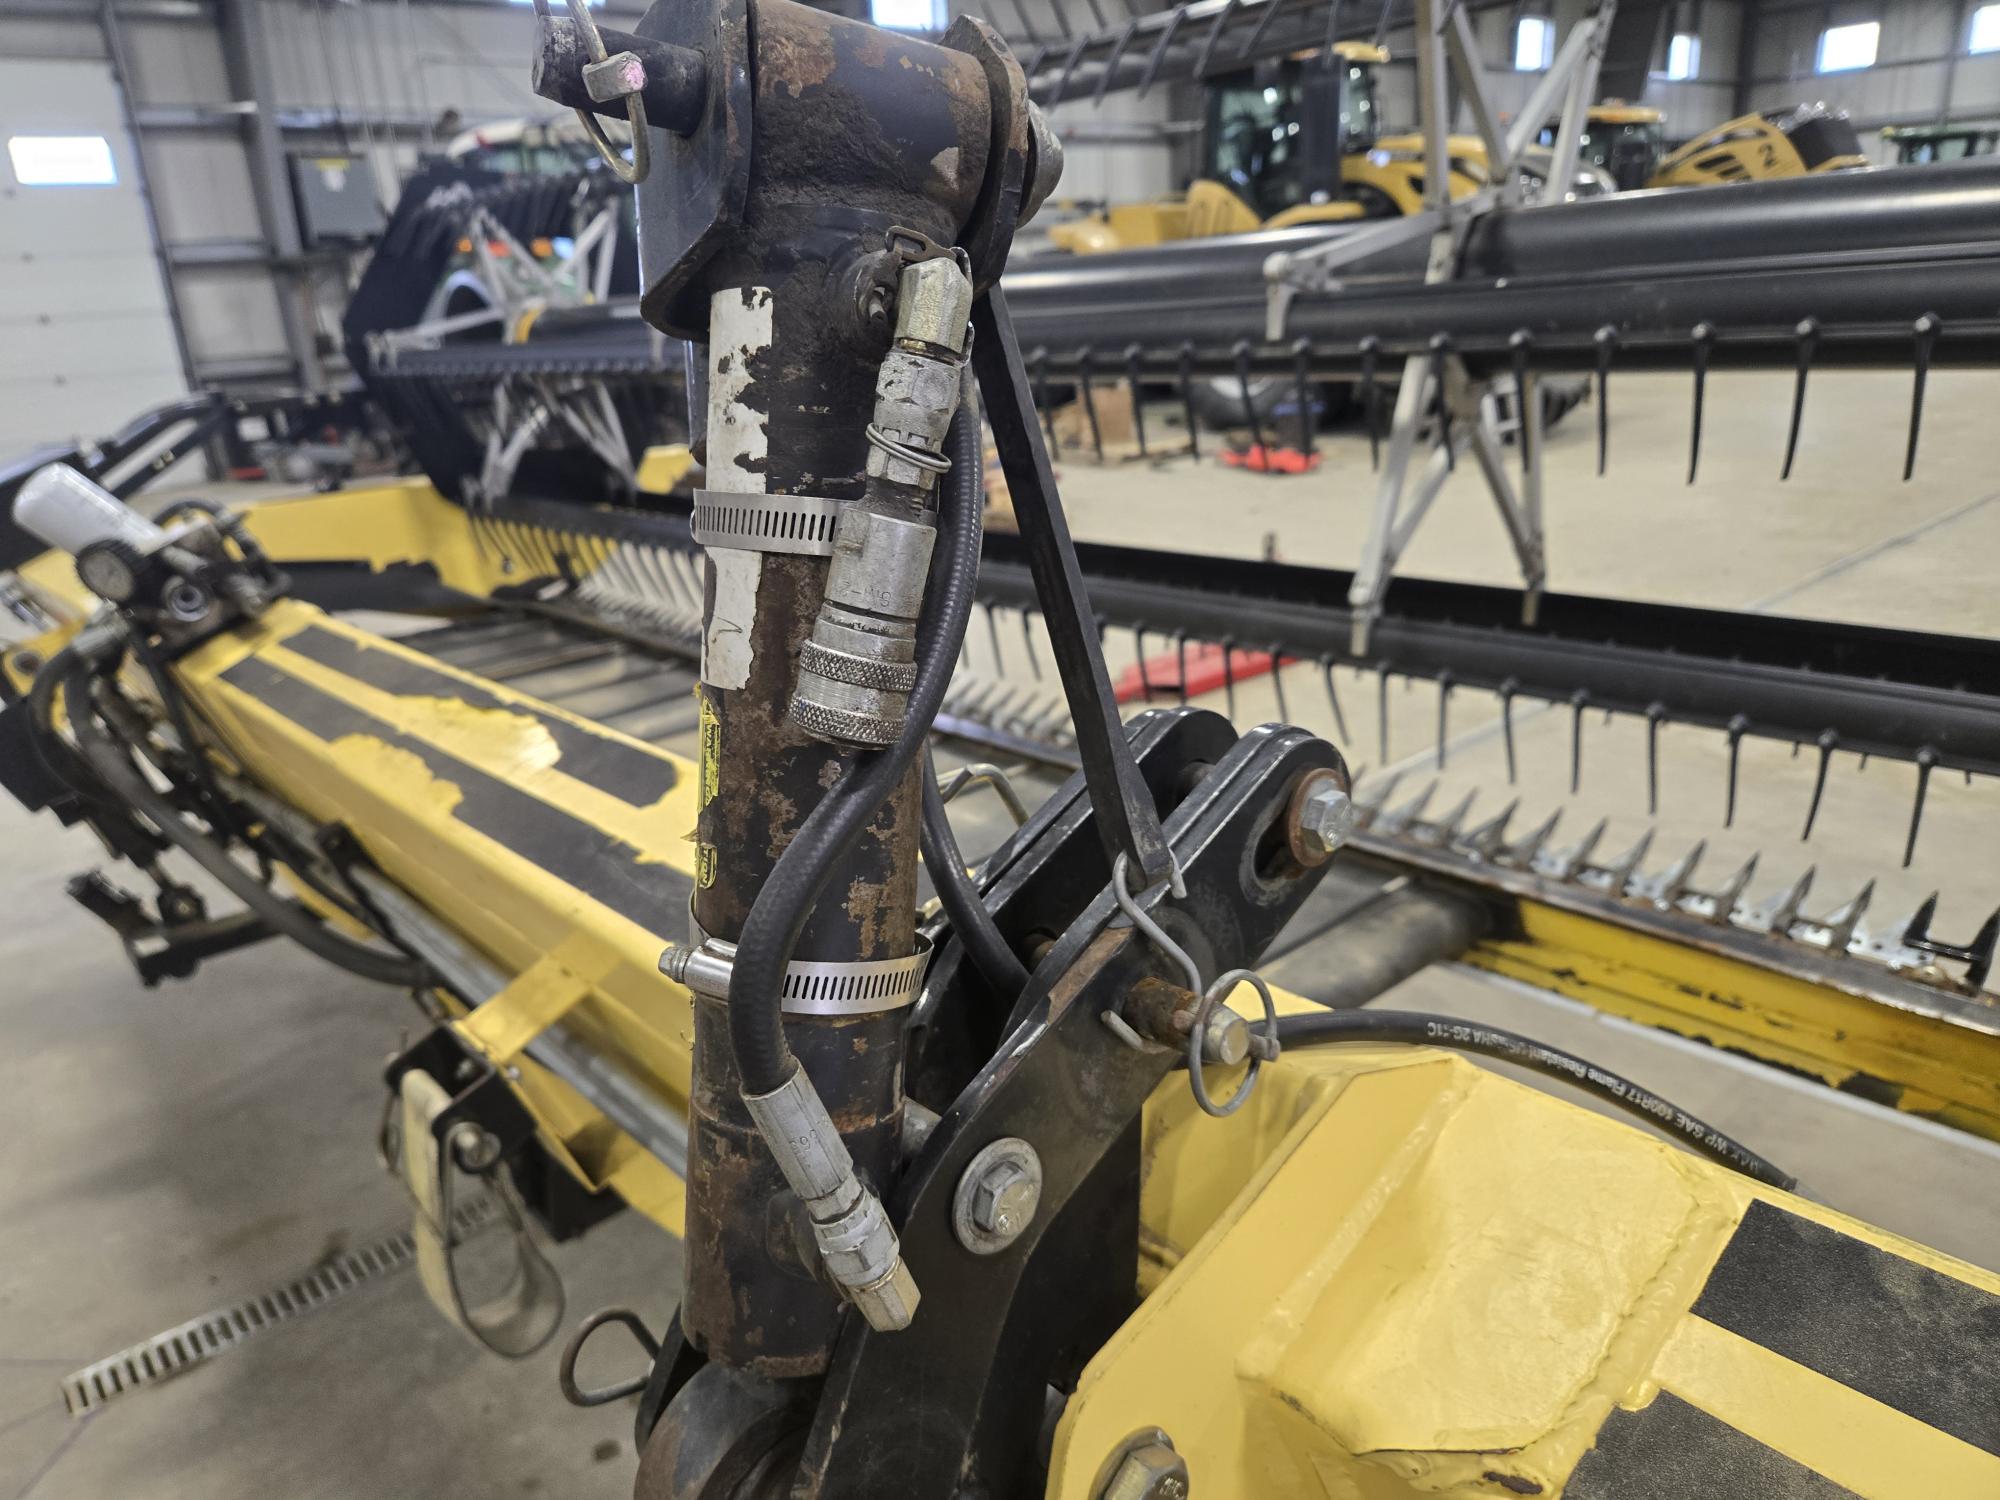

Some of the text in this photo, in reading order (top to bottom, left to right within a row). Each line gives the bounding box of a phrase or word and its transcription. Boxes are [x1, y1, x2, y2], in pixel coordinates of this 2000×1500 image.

[1527, 1044, 1588, 1079] Resistant
[1587, 1067, 1627, 1097] Flame
[1626, 1088, 1674, 1121] 100R17
[1675, 1112, 1705, 1138] SAE
[1704, 1134, 1729, 1155] WP
